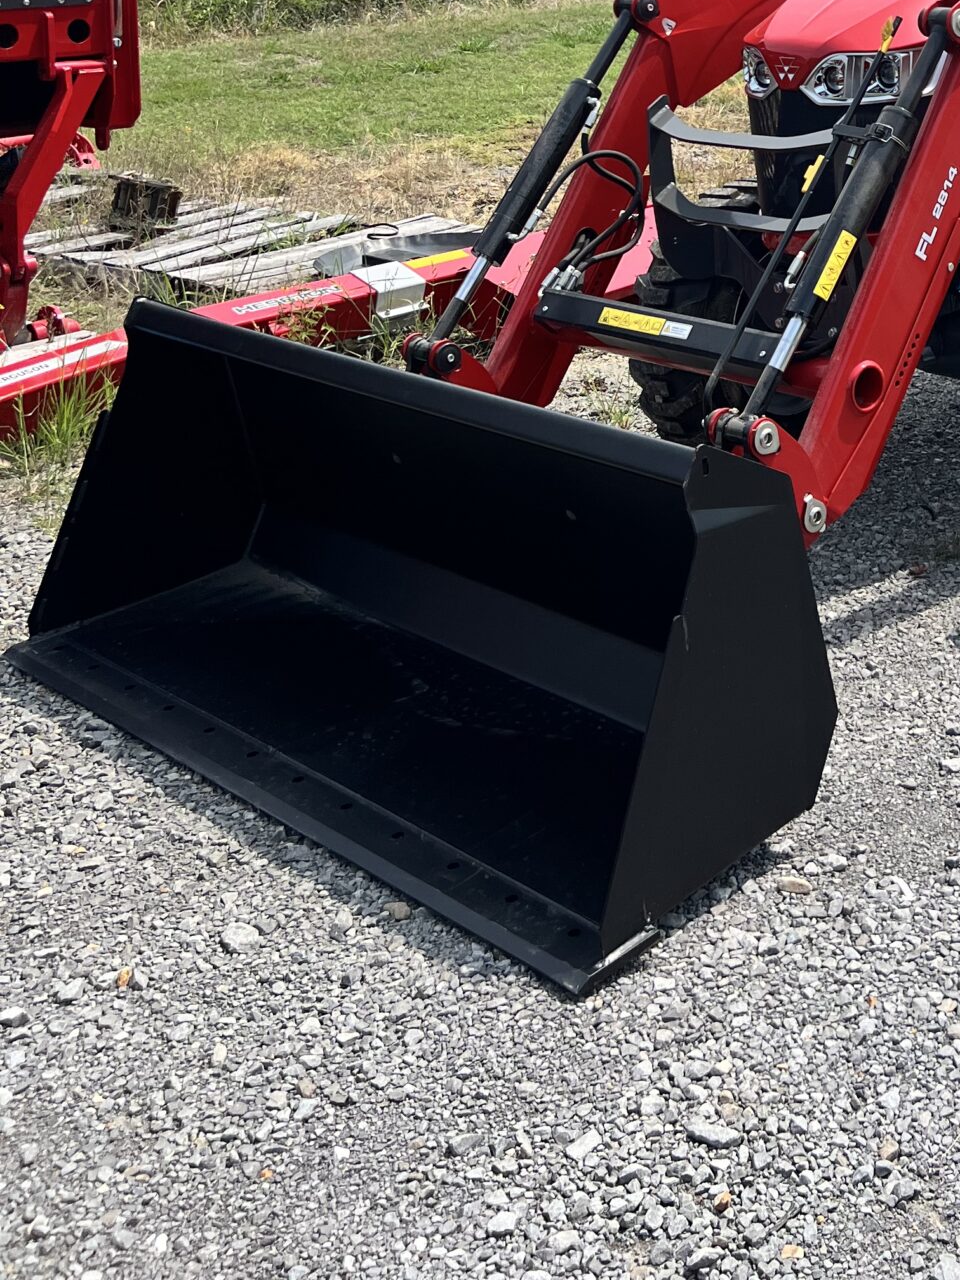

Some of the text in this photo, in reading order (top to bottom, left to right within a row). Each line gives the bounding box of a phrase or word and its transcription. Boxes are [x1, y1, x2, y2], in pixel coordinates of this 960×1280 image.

[914, 166, 958, 262] FL 2814
[0, 362, 50, 384] RGUSON
